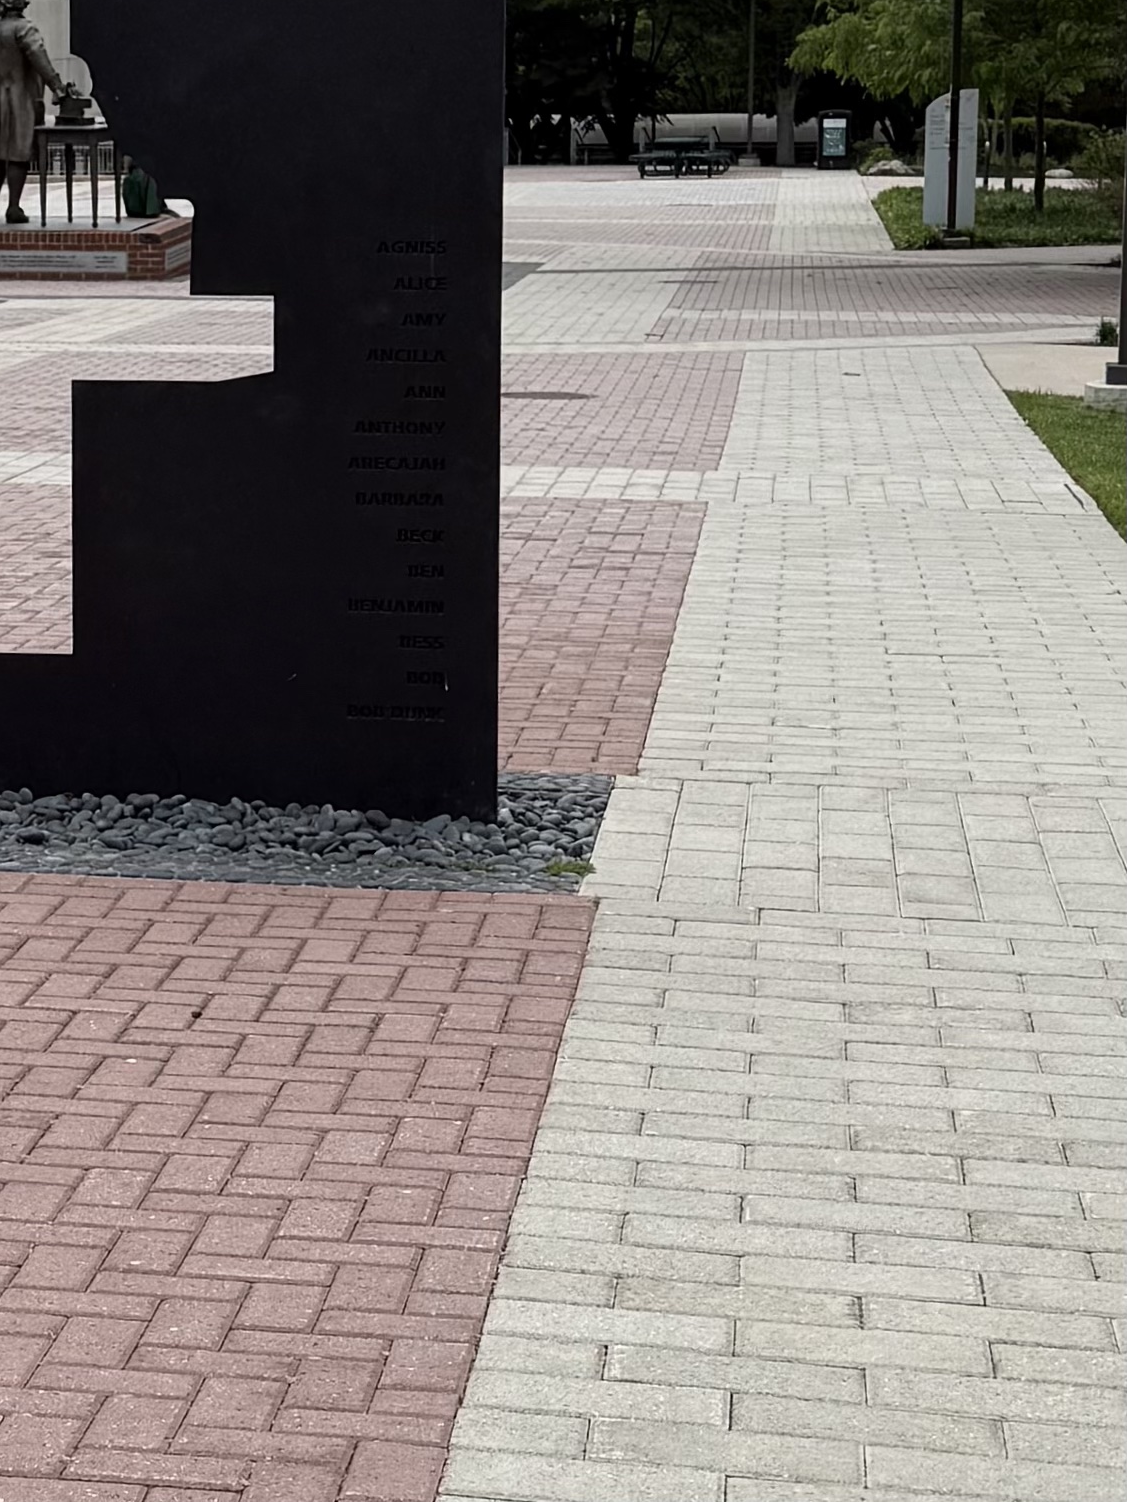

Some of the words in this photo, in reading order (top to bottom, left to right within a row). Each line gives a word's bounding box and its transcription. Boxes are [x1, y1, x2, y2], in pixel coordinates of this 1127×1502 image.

[377, 241, 447, 254] AGNISS
[394, 277, 447, 290] ALICE
[401, 313, 446, 326] AMY
[366, 348, 446, 363] ANCILLA
[404, 385, 446, 399] ANN
[354, 420, 446, 435] ANTHONY
[355, 492, 444, 506] BARBARA
[396, 528, 445, 542] BECK
[408, 564, 444, 578] BEN
[348, 598, 445, 613] BENJAMIN
[399, 635, 445, 649] BESS
[406, 671, 444, 684] BOB
[347, 704, 385, 718] BOB
